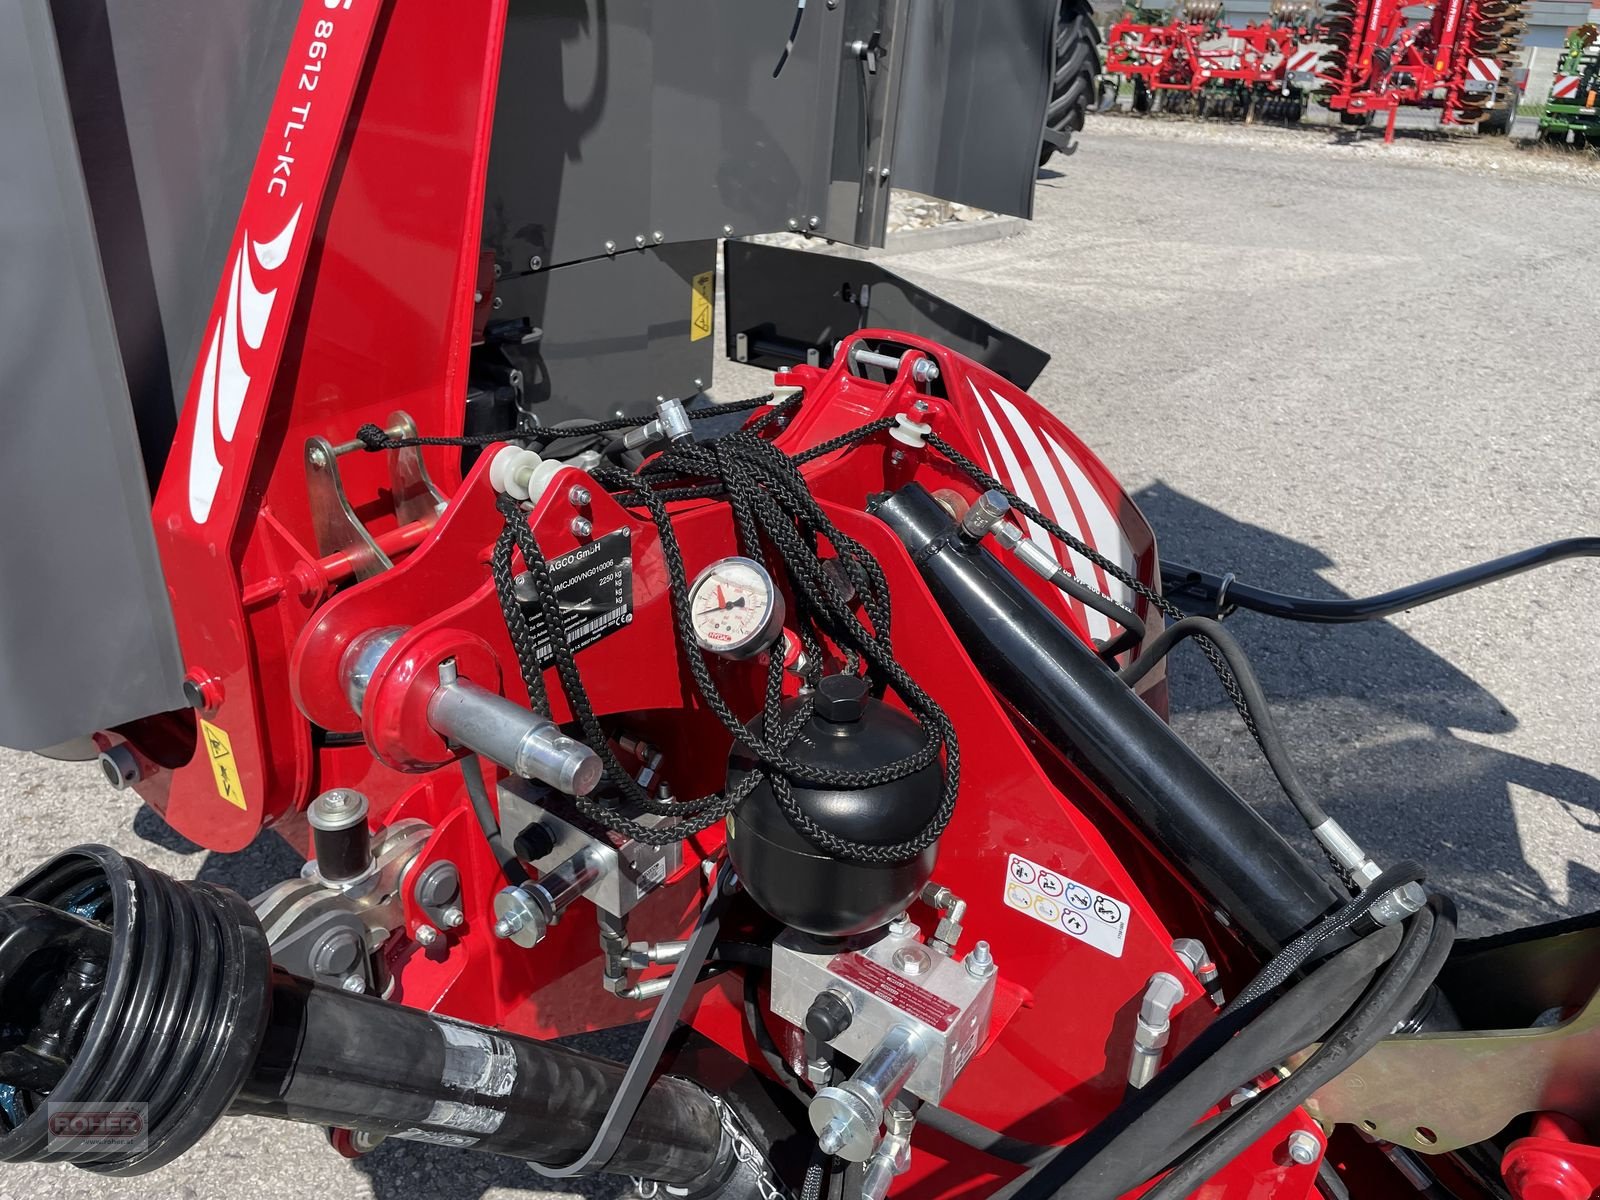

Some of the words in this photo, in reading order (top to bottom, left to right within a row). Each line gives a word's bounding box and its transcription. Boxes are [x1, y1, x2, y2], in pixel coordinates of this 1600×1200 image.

[298, 20, 334, 92] 8612
[266, 103, 311, 198] TL-KC
[548, 555, 575, 574] AGCO
[576, 542, 602, 561] GmbH
[599, 573, 614, 586] 2250
[615, 570, 622, 579] kg
[615, 579, 623, 587] kg
[615, 588, 623, 596] kg
[615, 595, 623, 604] kg
